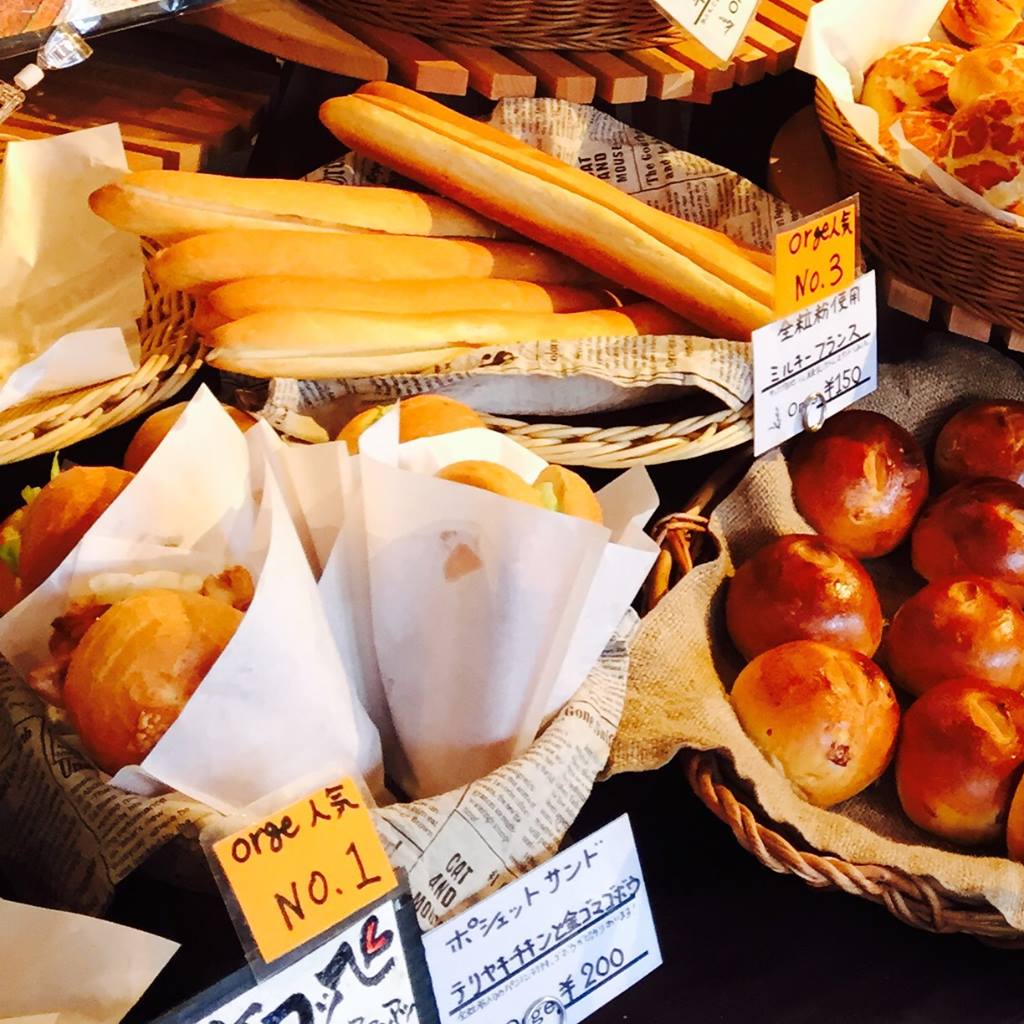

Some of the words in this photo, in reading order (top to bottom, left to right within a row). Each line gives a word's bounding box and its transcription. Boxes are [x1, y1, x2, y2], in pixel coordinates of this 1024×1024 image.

[777, 285, 862, 343] 全粒粉使用
[769, 354, 812, 384] ミルキー
[824, 365, 862, 397] ¥150
[310, 784, 360, 828] 人気
[445, 852, 474, 885] CAT
[428, 872, 458, 909] AND
[445, 886, 540, 954] ポシェット
[544, 839, 605, 895] サンド
[558, 947, 625, 1004] ¥200
